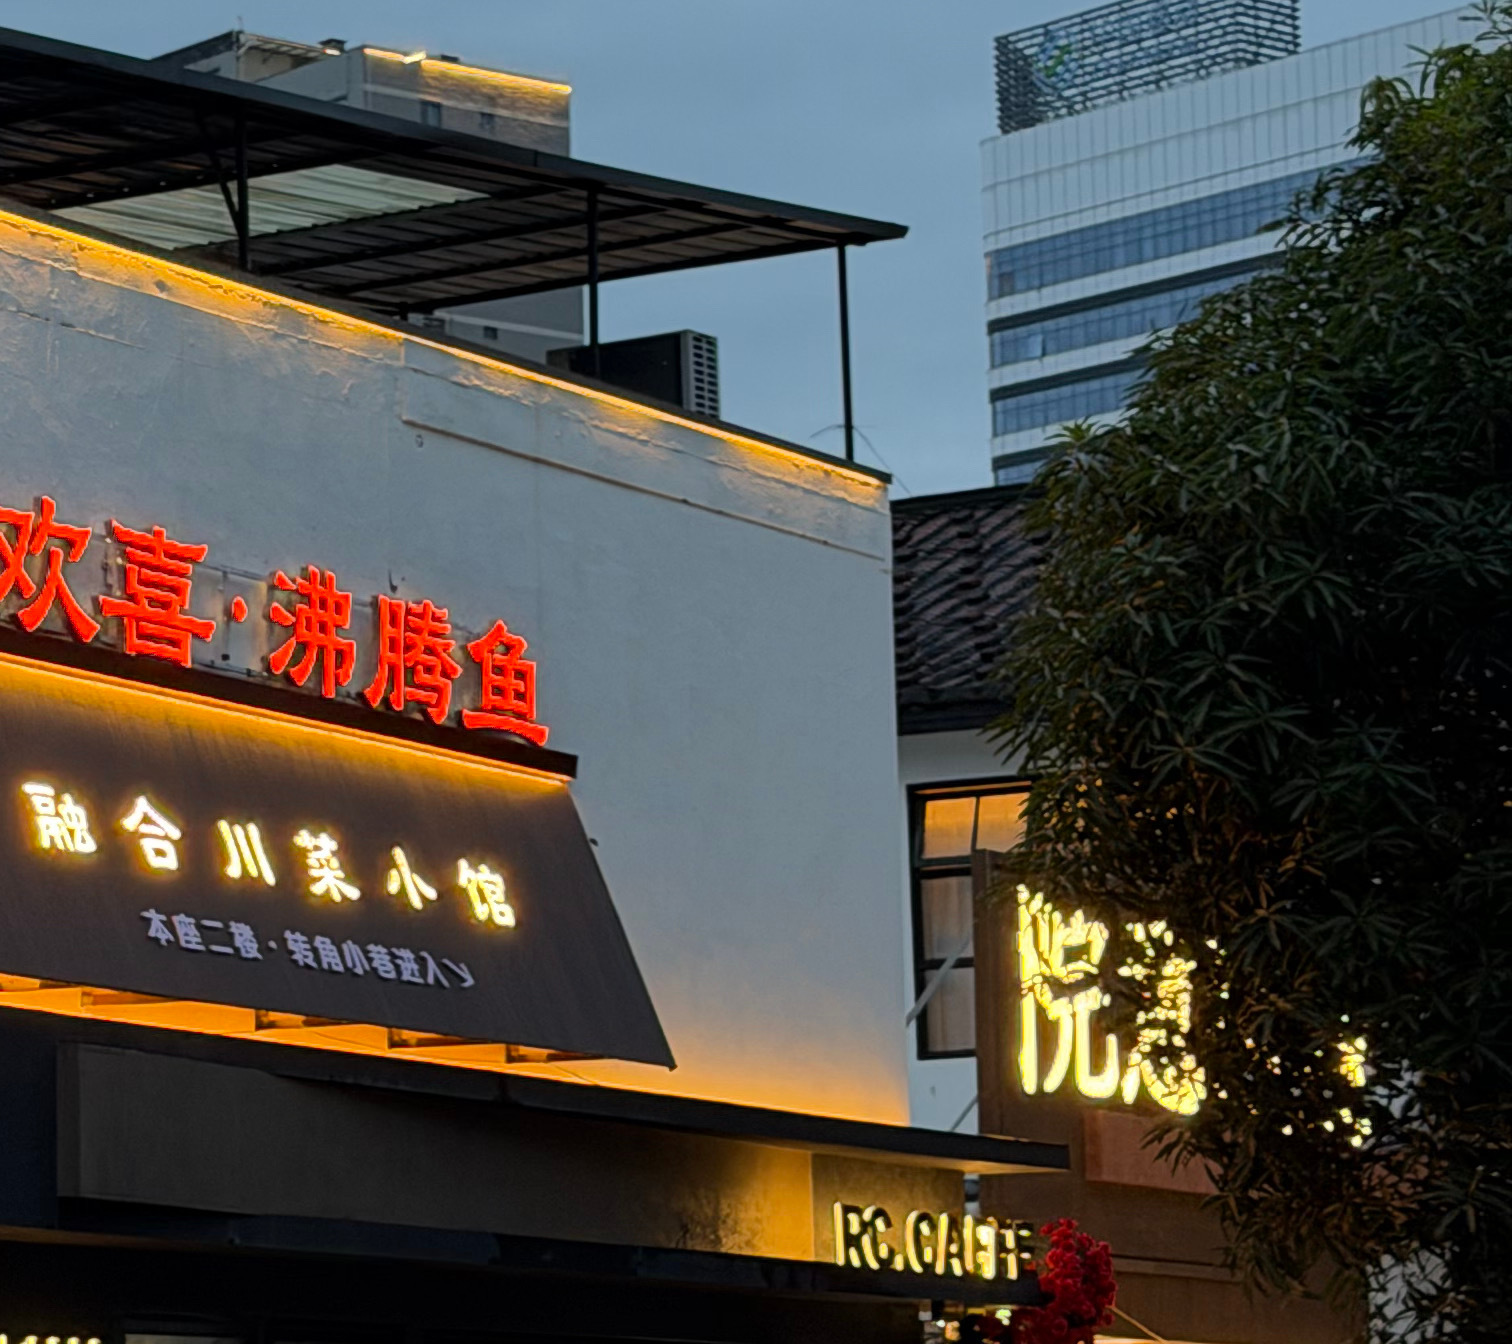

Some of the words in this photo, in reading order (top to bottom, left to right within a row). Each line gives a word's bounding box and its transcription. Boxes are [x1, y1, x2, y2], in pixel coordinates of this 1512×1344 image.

[21, 781, 518, 928] 融合川菜小馆
